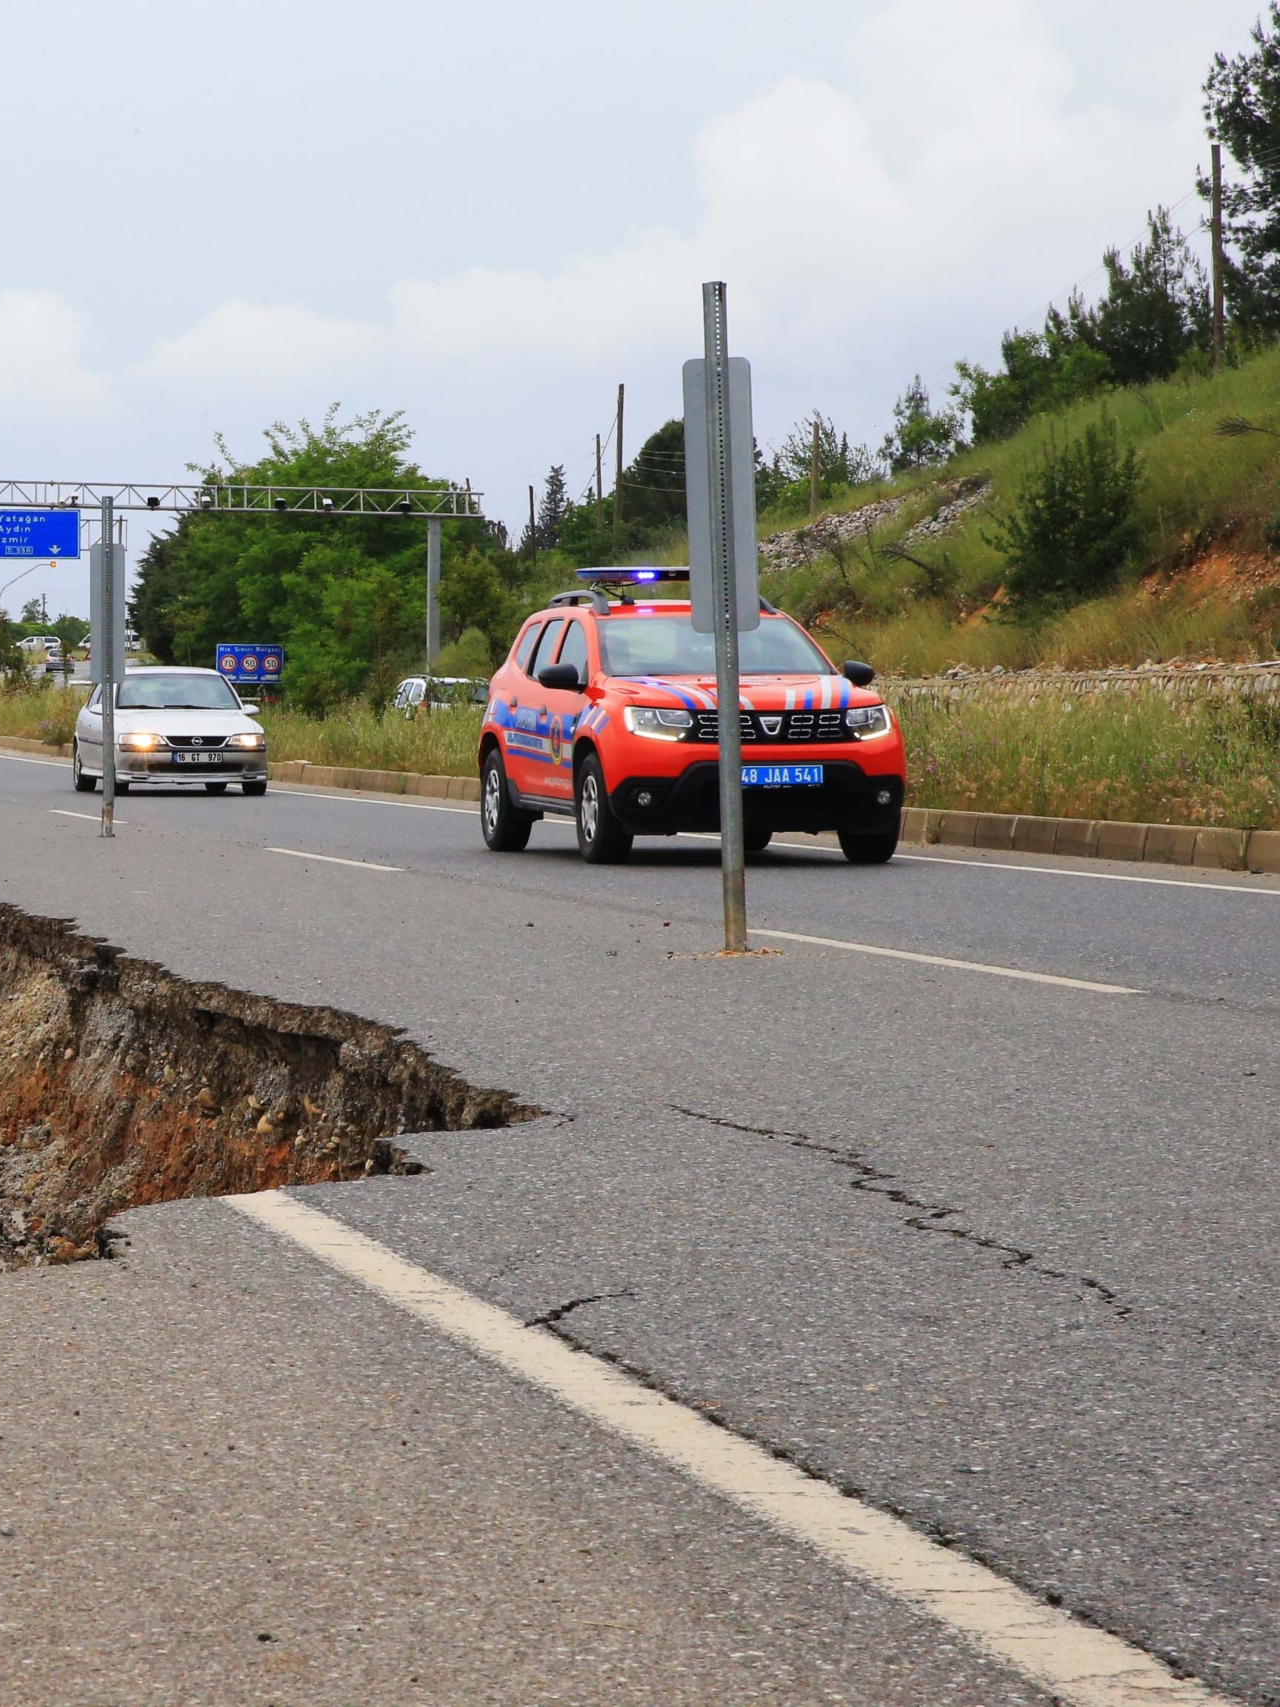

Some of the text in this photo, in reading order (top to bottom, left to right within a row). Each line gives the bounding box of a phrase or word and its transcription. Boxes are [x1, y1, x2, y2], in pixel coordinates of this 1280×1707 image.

[224, 659, 234, 667] 70
[245, 659, 255, 667] 50
[266, 659, 276, 667] 50
[191, 753, 200, 761] GT
[208, 753, 221, 761] 970
[741, 768, 818, 783] 48 JAA 541
